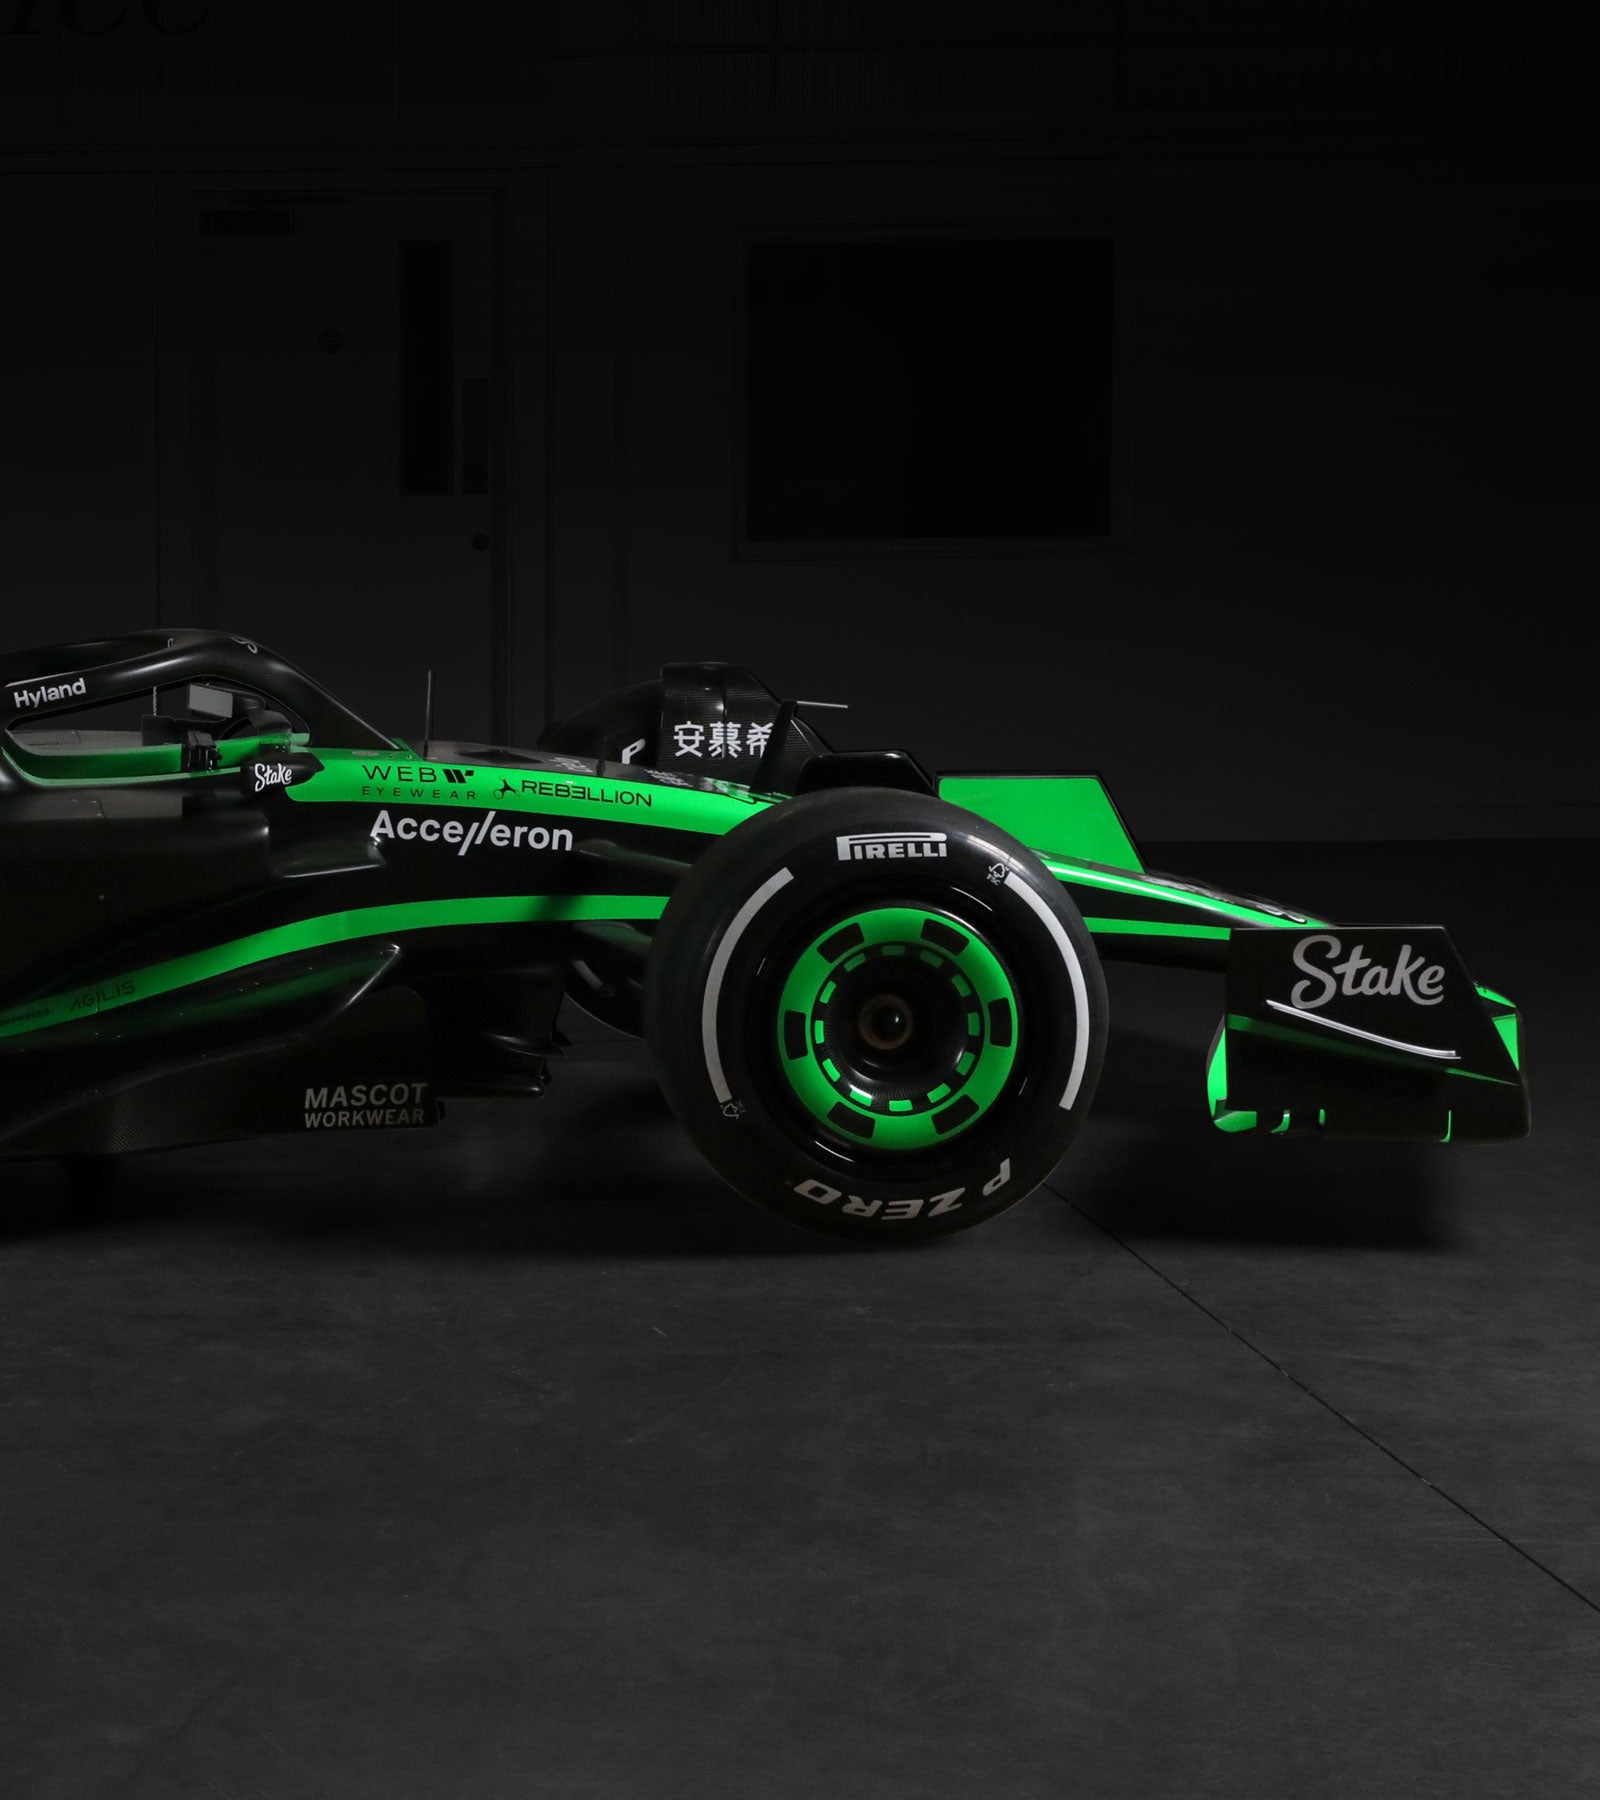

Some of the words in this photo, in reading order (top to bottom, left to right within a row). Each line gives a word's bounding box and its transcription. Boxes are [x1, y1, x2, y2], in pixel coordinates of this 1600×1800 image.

[13, 677, 88, 709] Hyland
[254, 763, 292, 792] Stake
[362, 765, 437, 783] WEB
[362, 786, 476, 800] EYEWEAR
[521, 780, 652, 807] REBELLION
[836, 832, 947, 860] PIRELLI
[1291, 934, 1445, 1010] Stake
[304, 1083, 428, 1109] MASCOT
[304, 1108, 425, 1128] WORKWEAR
[982, 1158, 1011, 1196] P
[793, 1179, 966, 1220] ZERO
